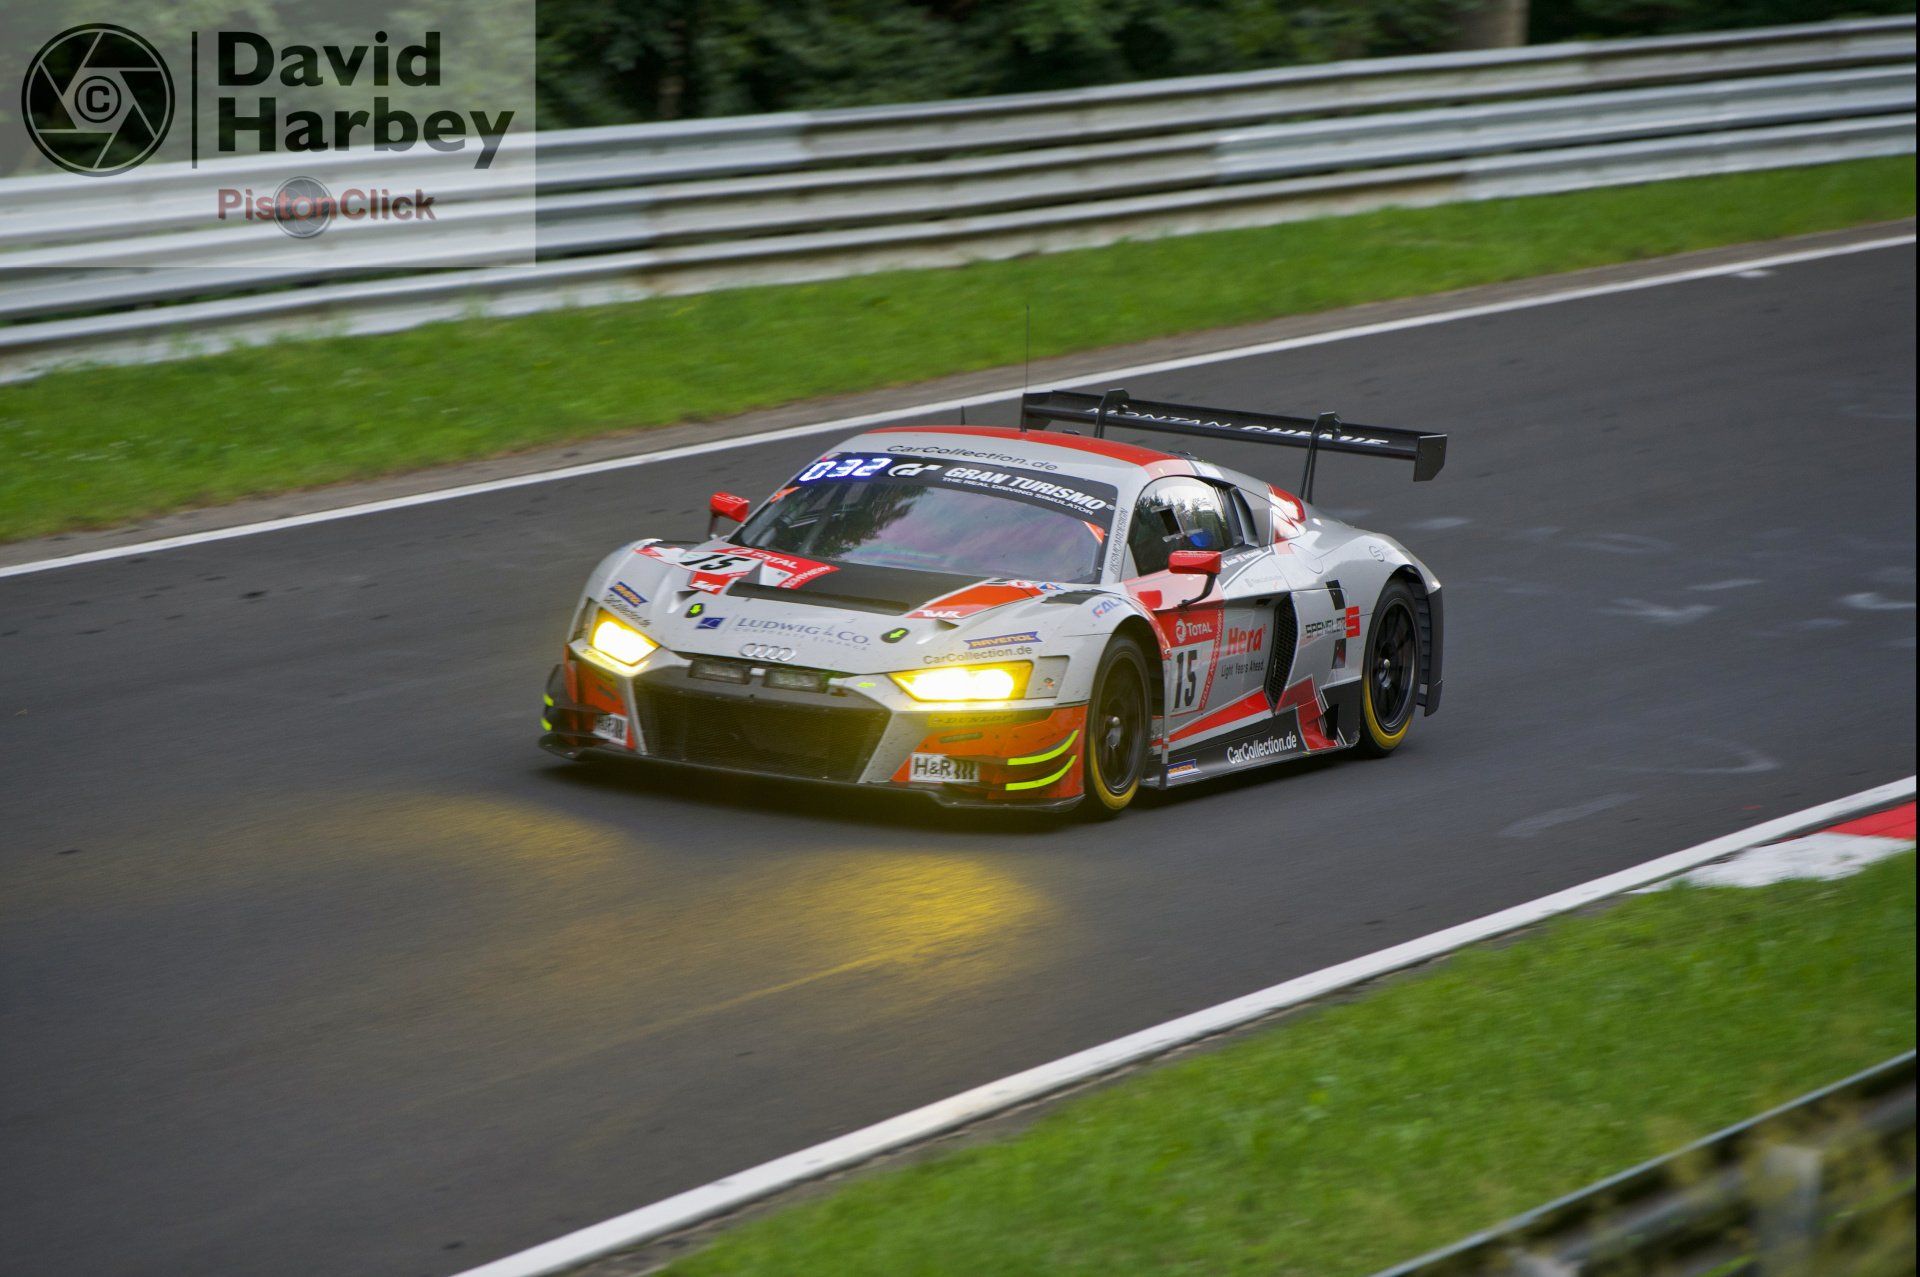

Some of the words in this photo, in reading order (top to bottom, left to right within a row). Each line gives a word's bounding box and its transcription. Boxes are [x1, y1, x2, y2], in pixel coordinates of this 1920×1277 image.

[886, 444, 1059, 471] CarCollection.de
[798, 457, 893, 482] 032
[943, 467, 1007, 484] GRAN
[942, 476, 963, 484] THE
[963, 479, 990, 489] REAL
[991, 484, 1034, 497] DRIVING
[1034, 493, 1095, 516] SIMULATOR
[678, 554, 751, 571] 15
[752, 551, 799, 569] TOTAL
[737, 618, 821, 635] LUDWIG
[1187, 621, 1213, 637] TOTAL
[969, 634, 1035, 648] RAVENOL
[1226, 626, 1263, 656] Hera
[923, 645, 1033, 665] CarCollection.de
[1174, 649, 1198, 709] 15
[1227, 731, 1297, 765] CarCollection.de
[913, 756, 951, 776] H&R
